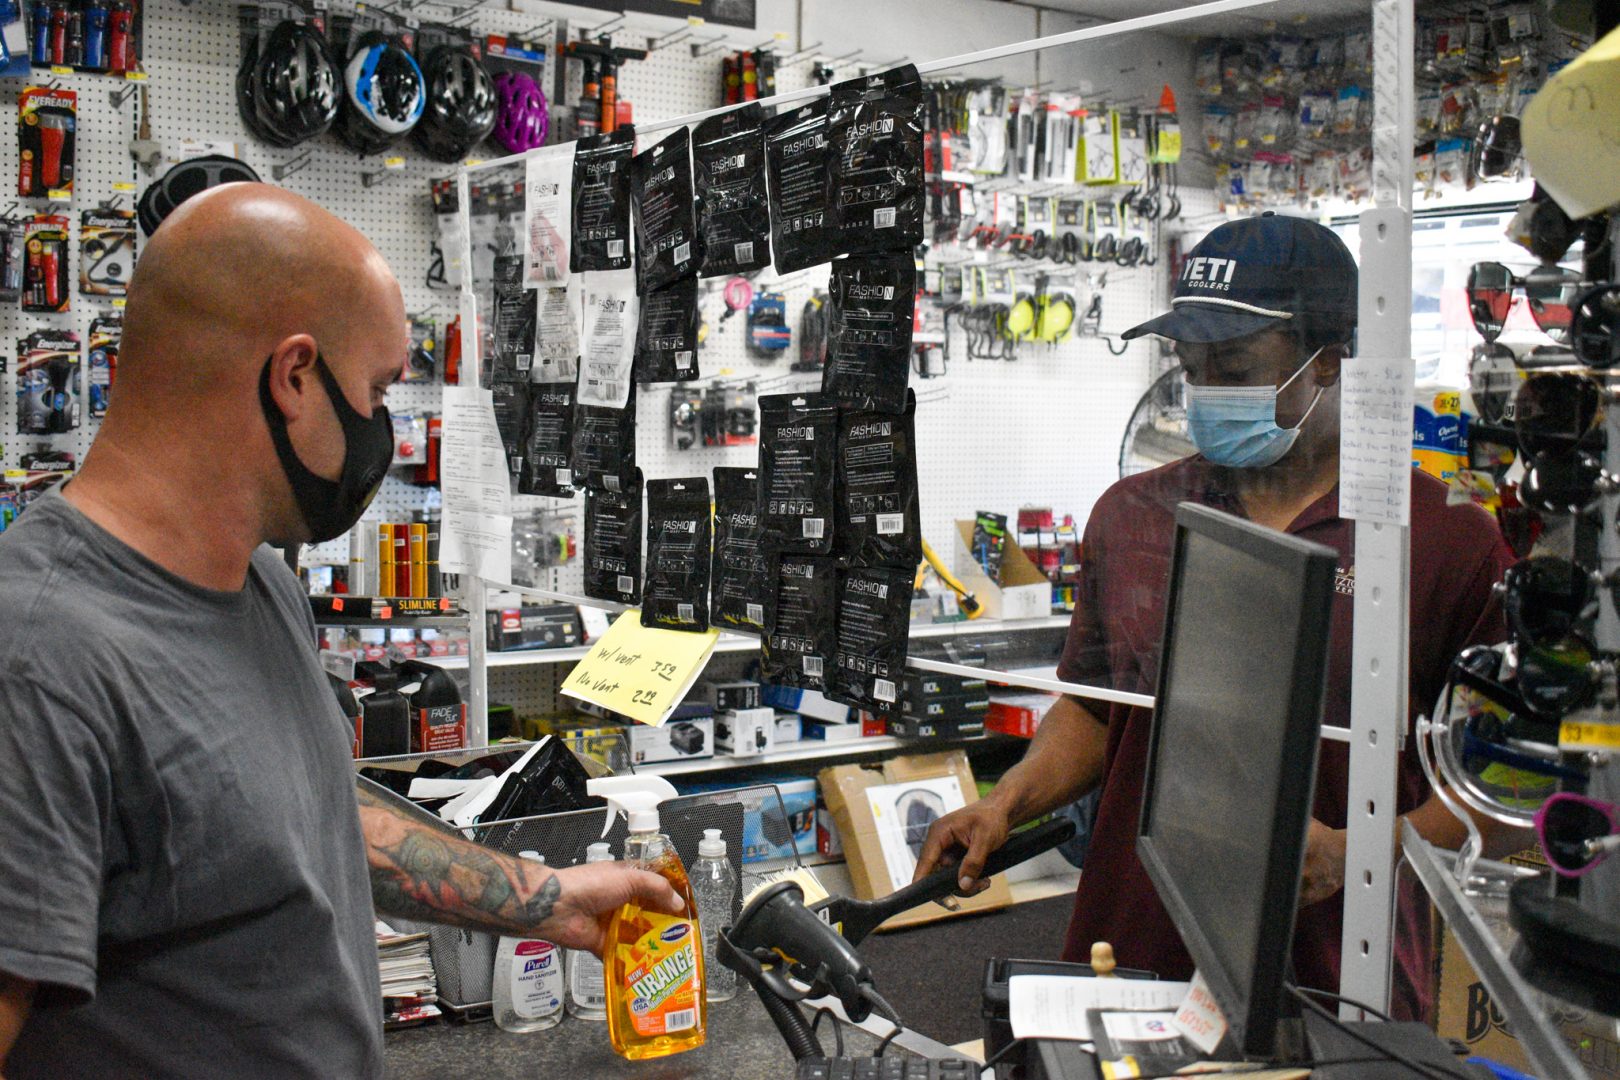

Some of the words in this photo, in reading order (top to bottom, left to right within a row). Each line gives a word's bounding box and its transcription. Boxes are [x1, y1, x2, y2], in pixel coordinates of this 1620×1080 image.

[28, 95, 74, 107] EVEREADY
[846, 118, 894, 138] FASHION
[783, 133, 823, 156] FASHION
[586, 161, 617, 175] FASHION
[711, 154, 745, 173] FASHION
[644, 165, 675, 191] FASHION
[1182, 256, 1236, 283] YETI
[848, 285, 895, 300] FASHION
[1188, 280, 1230, 291] COOLERS
[541, 393, 570, 406] FASHION
[777, 426, 814, 441] FASHION
[849, 421, 892, 438] FASHION
[663, 520, 697, 533] FASHION
[731, 513, 758, 526] FASHIO
[780, 563, 814, 579] ASHION
[846, 577, 889, 599] FASHION
[399, 600, 437, 610] SLIMLINE
[431, 707, 453, 718] FADE
[628, 967, 645, 983] NEW!
[632, 943, 695, 1001] ORANGE
[633, 1002, 649, 1012] USA
